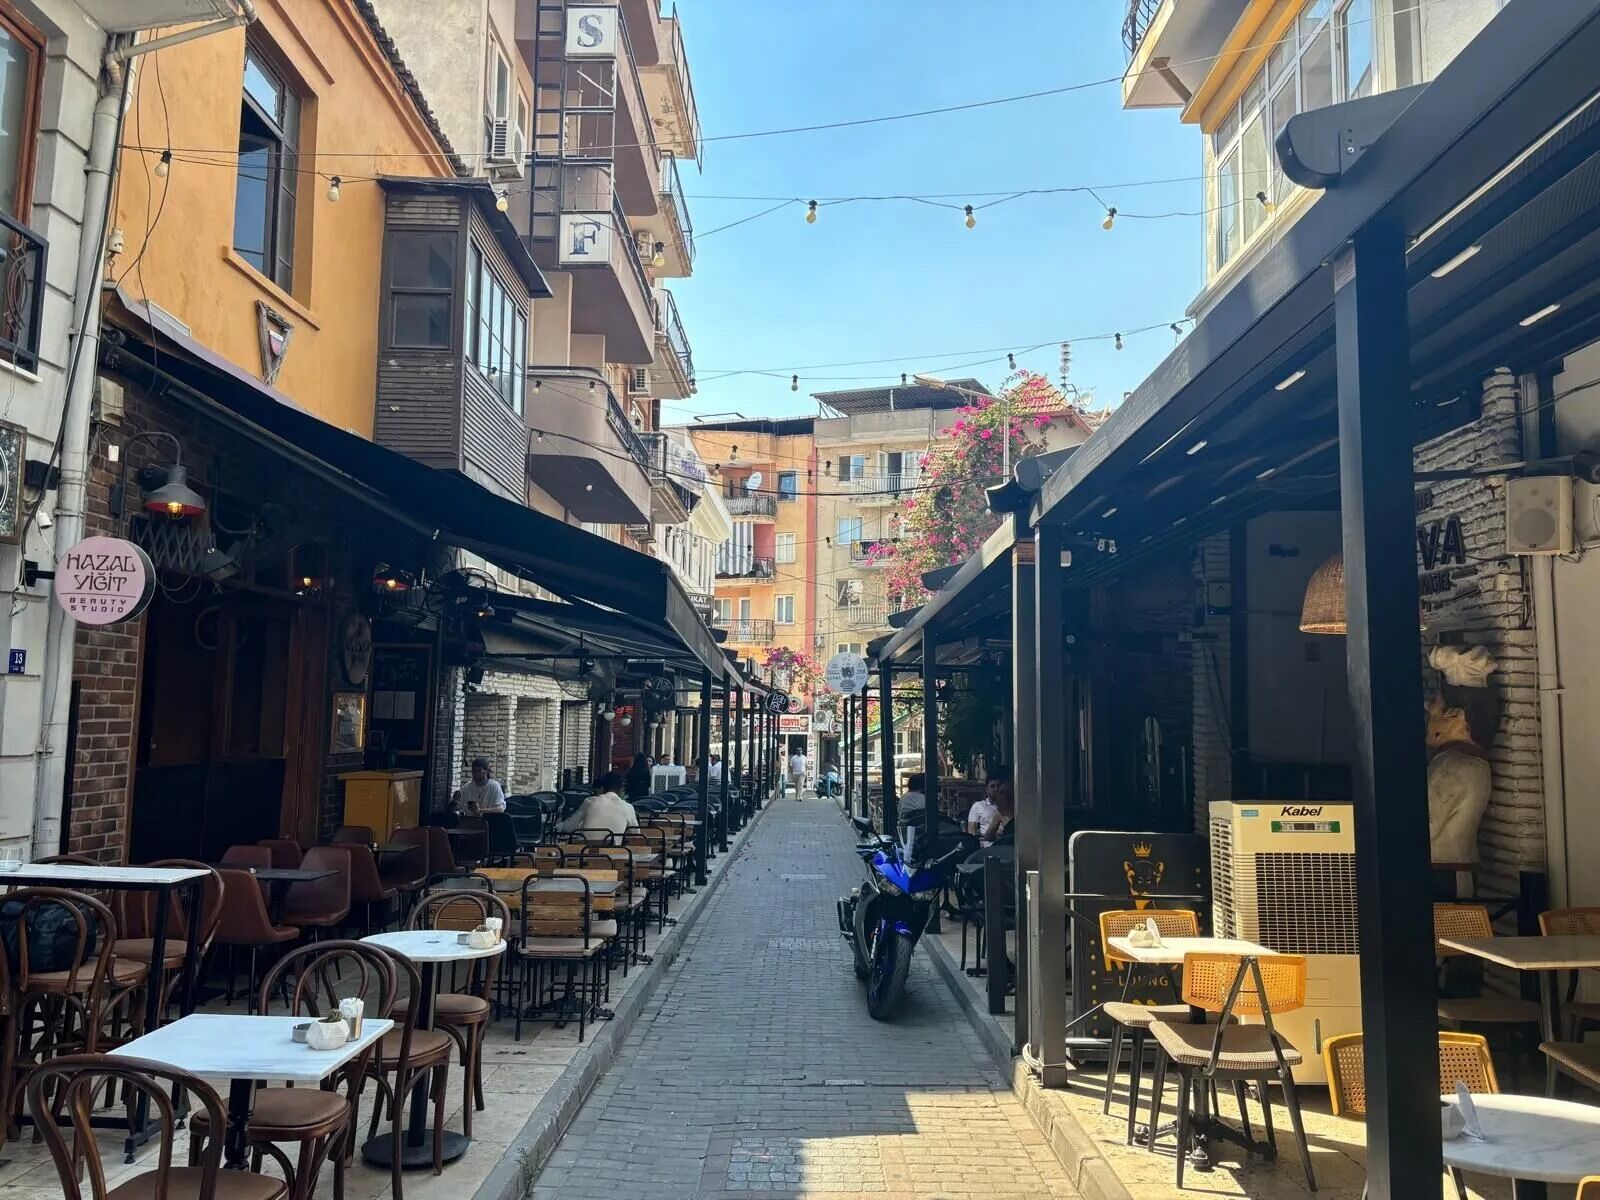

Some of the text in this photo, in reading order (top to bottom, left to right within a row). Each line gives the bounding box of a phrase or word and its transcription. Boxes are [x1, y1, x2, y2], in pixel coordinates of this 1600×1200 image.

[577, 14, 603, 47] S
[569, 221, 601, 255] F
[1416, 515, 1466, 571] VA
[66, 553, 136, 573] HAZAL
[73, 571, 128, 592] YİĞİT
[69, 597, 127, 605] BEAUTY
[70, 604, 125, 613] STUDIO
[15, 652, 23, 664] 13
[1280, 806, 1323, 816] Kabel
